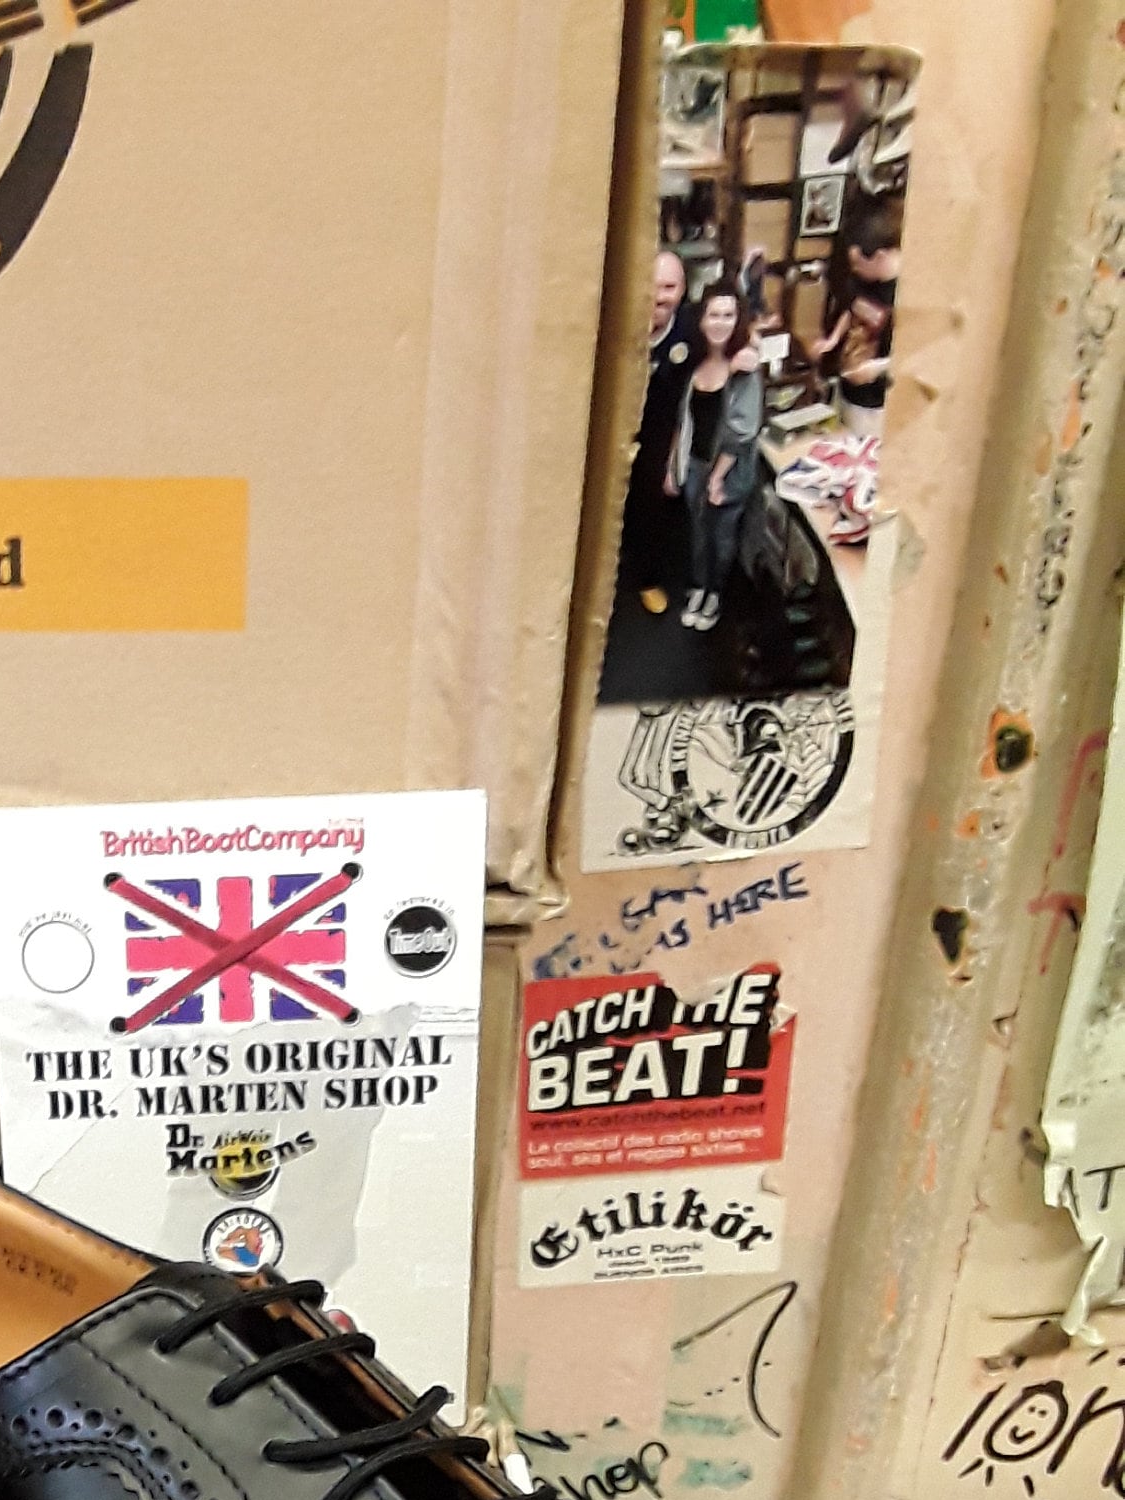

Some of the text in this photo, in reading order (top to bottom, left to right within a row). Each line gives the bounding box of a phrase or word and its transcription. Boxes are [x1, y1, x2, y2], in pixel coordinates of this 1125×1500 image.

[527, 985, 657, 1060] CATCH
[25, 1036, 452, 1082] THE UK'S ORIGINAL
[527, 1028, 750, 1111] BEAT!
[47, 1075, 439, 1120] DR. MARTEN SHOP
[166, 1131, 318, 1177] Martens
